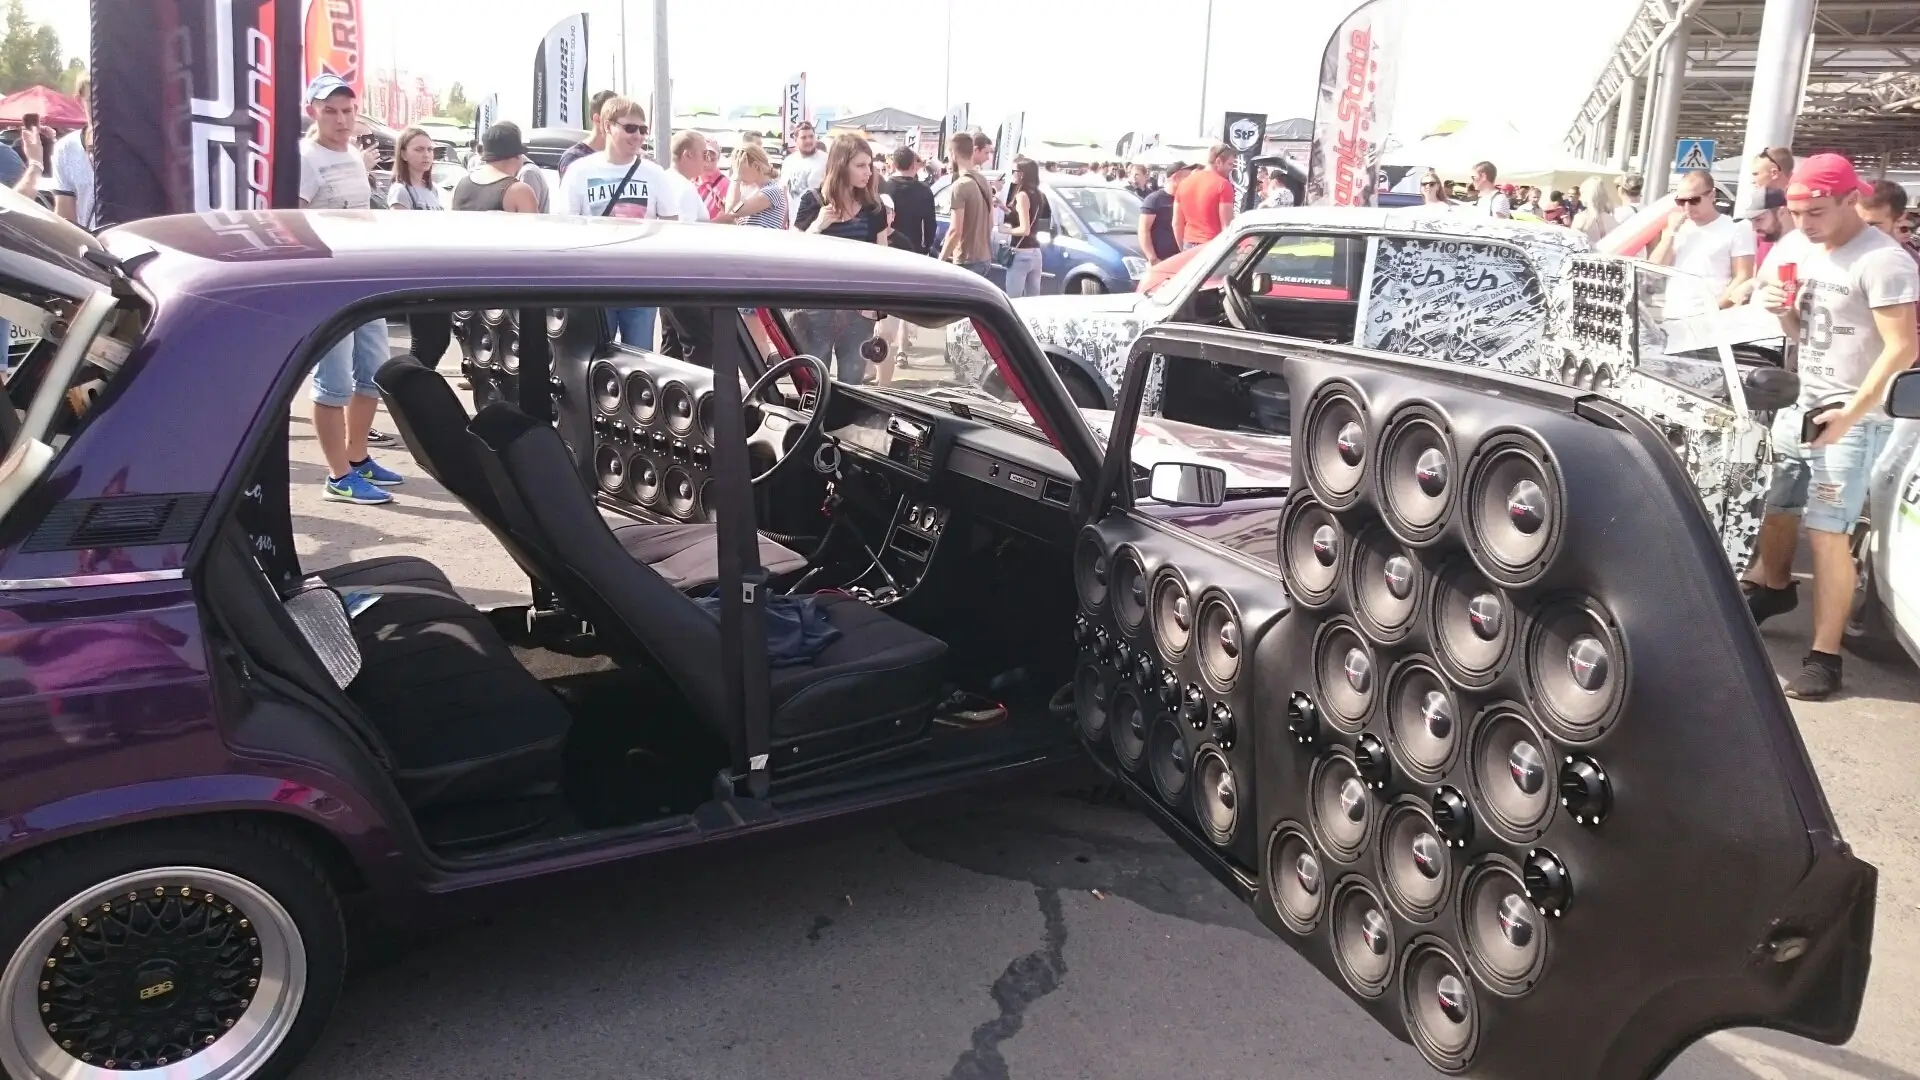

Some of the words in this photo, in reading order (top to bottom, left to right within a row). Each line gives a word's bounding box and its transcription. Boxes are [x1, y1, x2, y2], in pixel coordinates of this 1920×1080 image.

[1339, 25, 1372, 122] State
[1233, 128, 1255, 141] StP
[1333, 129, 1358, 207] amic
[588, 183, 648, 202] HAVNA
[140, 980, 174, 1000] BBS
